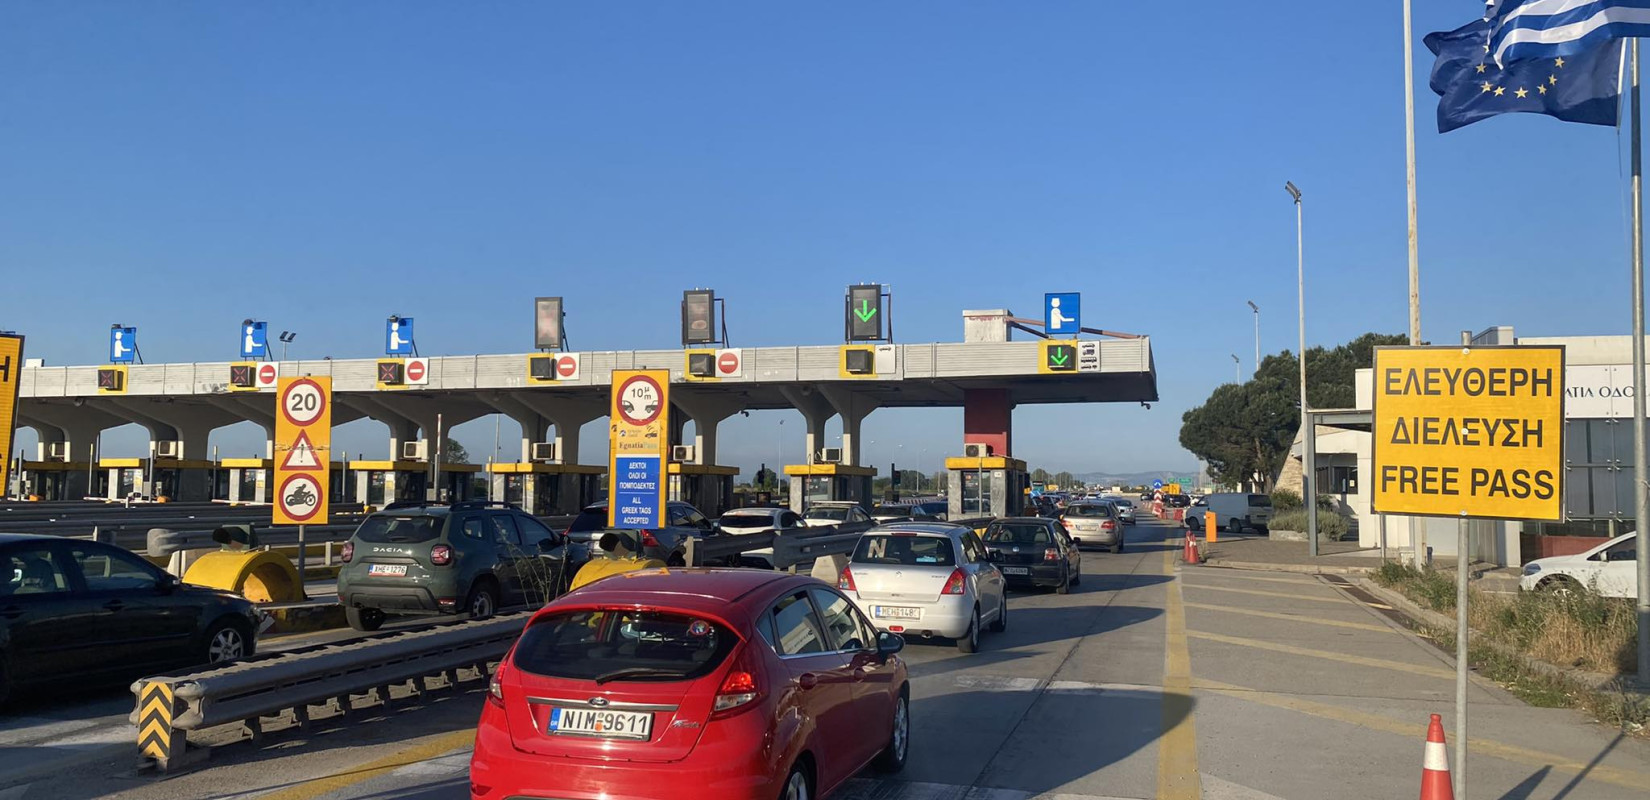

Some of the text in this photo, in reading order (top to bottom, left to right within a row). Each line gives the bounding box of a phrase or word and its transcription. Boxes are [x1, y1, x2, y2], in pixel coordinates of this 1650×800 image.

[1385, 367, 1552, 397] ΕΛΕΥΘΕΡΗ
[1599, 386, 1634, 398] ΟΔΟ
[291, 393, 317, 411] 20
[631, 388, 643, 398] 10
[1390, 416, 1543, 448] ΔΙΕΛΕΥΣΗ
[1381, 465, 1554, 500] FREE PASS
[867, 538, 887, 558] N
